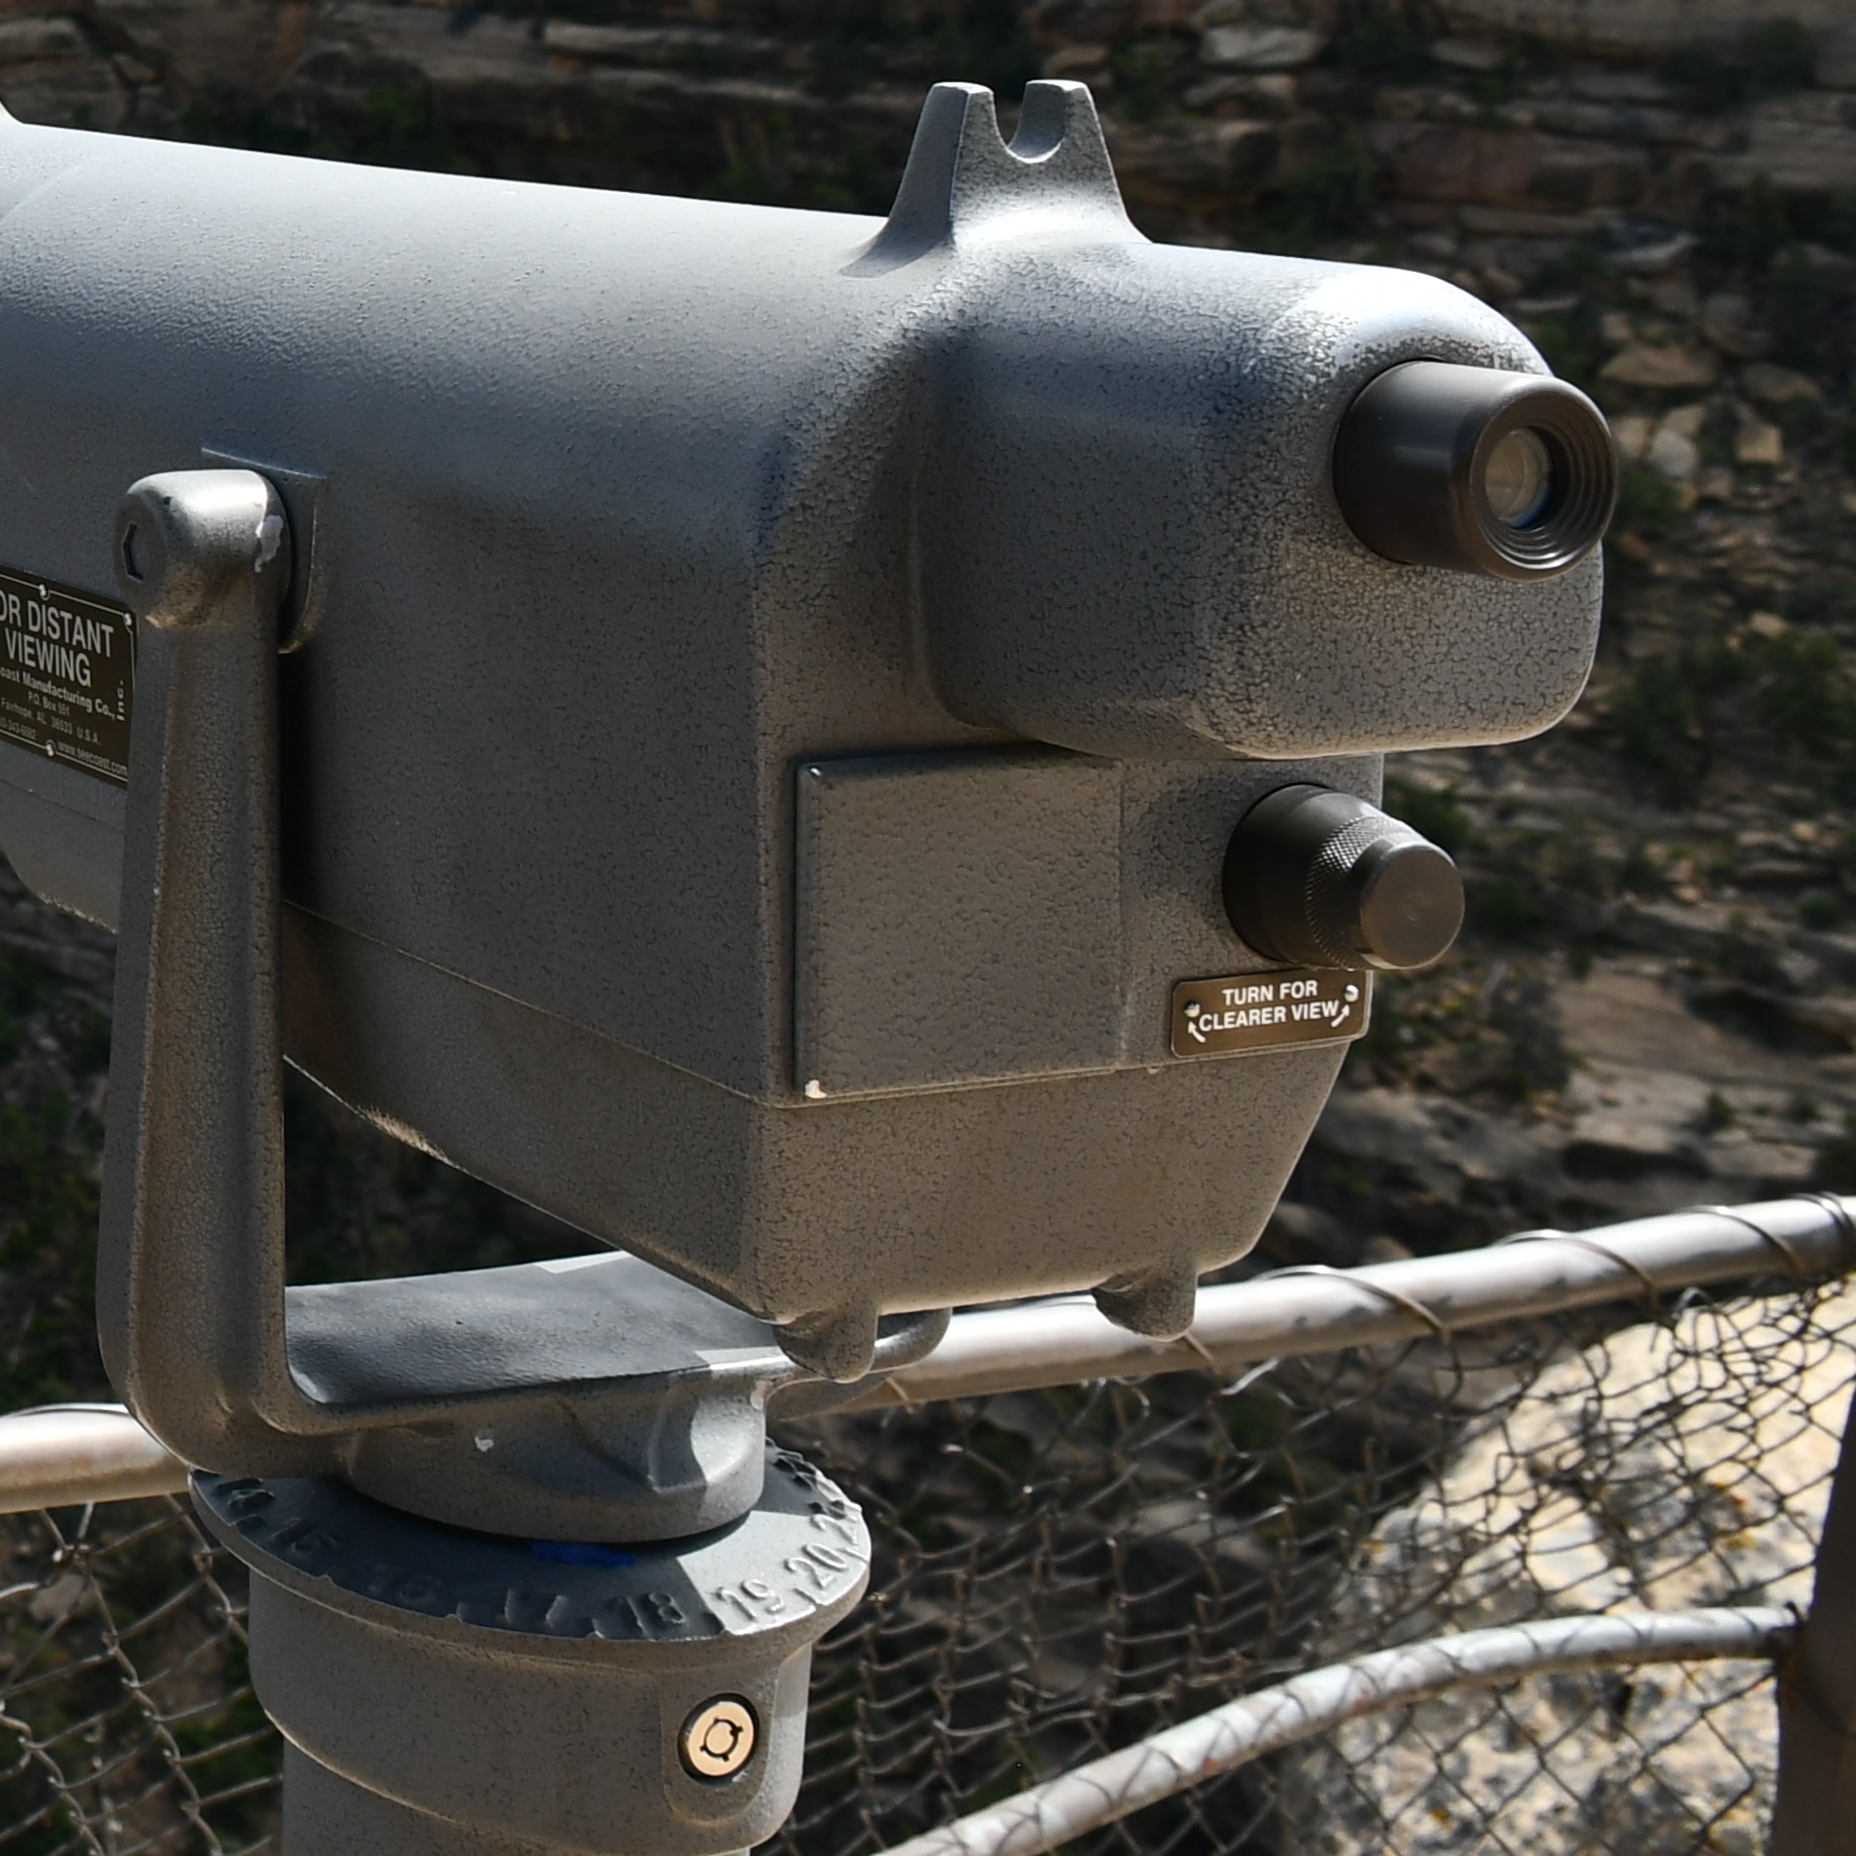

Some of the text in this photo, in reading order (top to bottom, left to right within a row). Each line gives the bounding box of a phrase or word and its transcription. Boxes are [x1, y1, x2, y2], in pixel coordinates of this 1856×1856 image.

[27, 600, 115, 658] DISTANT
[4, 628, 92, 688] VIEWING
[22, 672, 93, 714] Manufacturing
[42, 696, 57, 712] Box
[1222, 980, 1318, 1006] TURN FOR
[1198, 1000, 1340, 1032] CLEARER VIEW
[614, 1590, 688, 1640] 18
[714, 1577, 785, 1621] 19
[784, 1542, 850, 1589] 20
